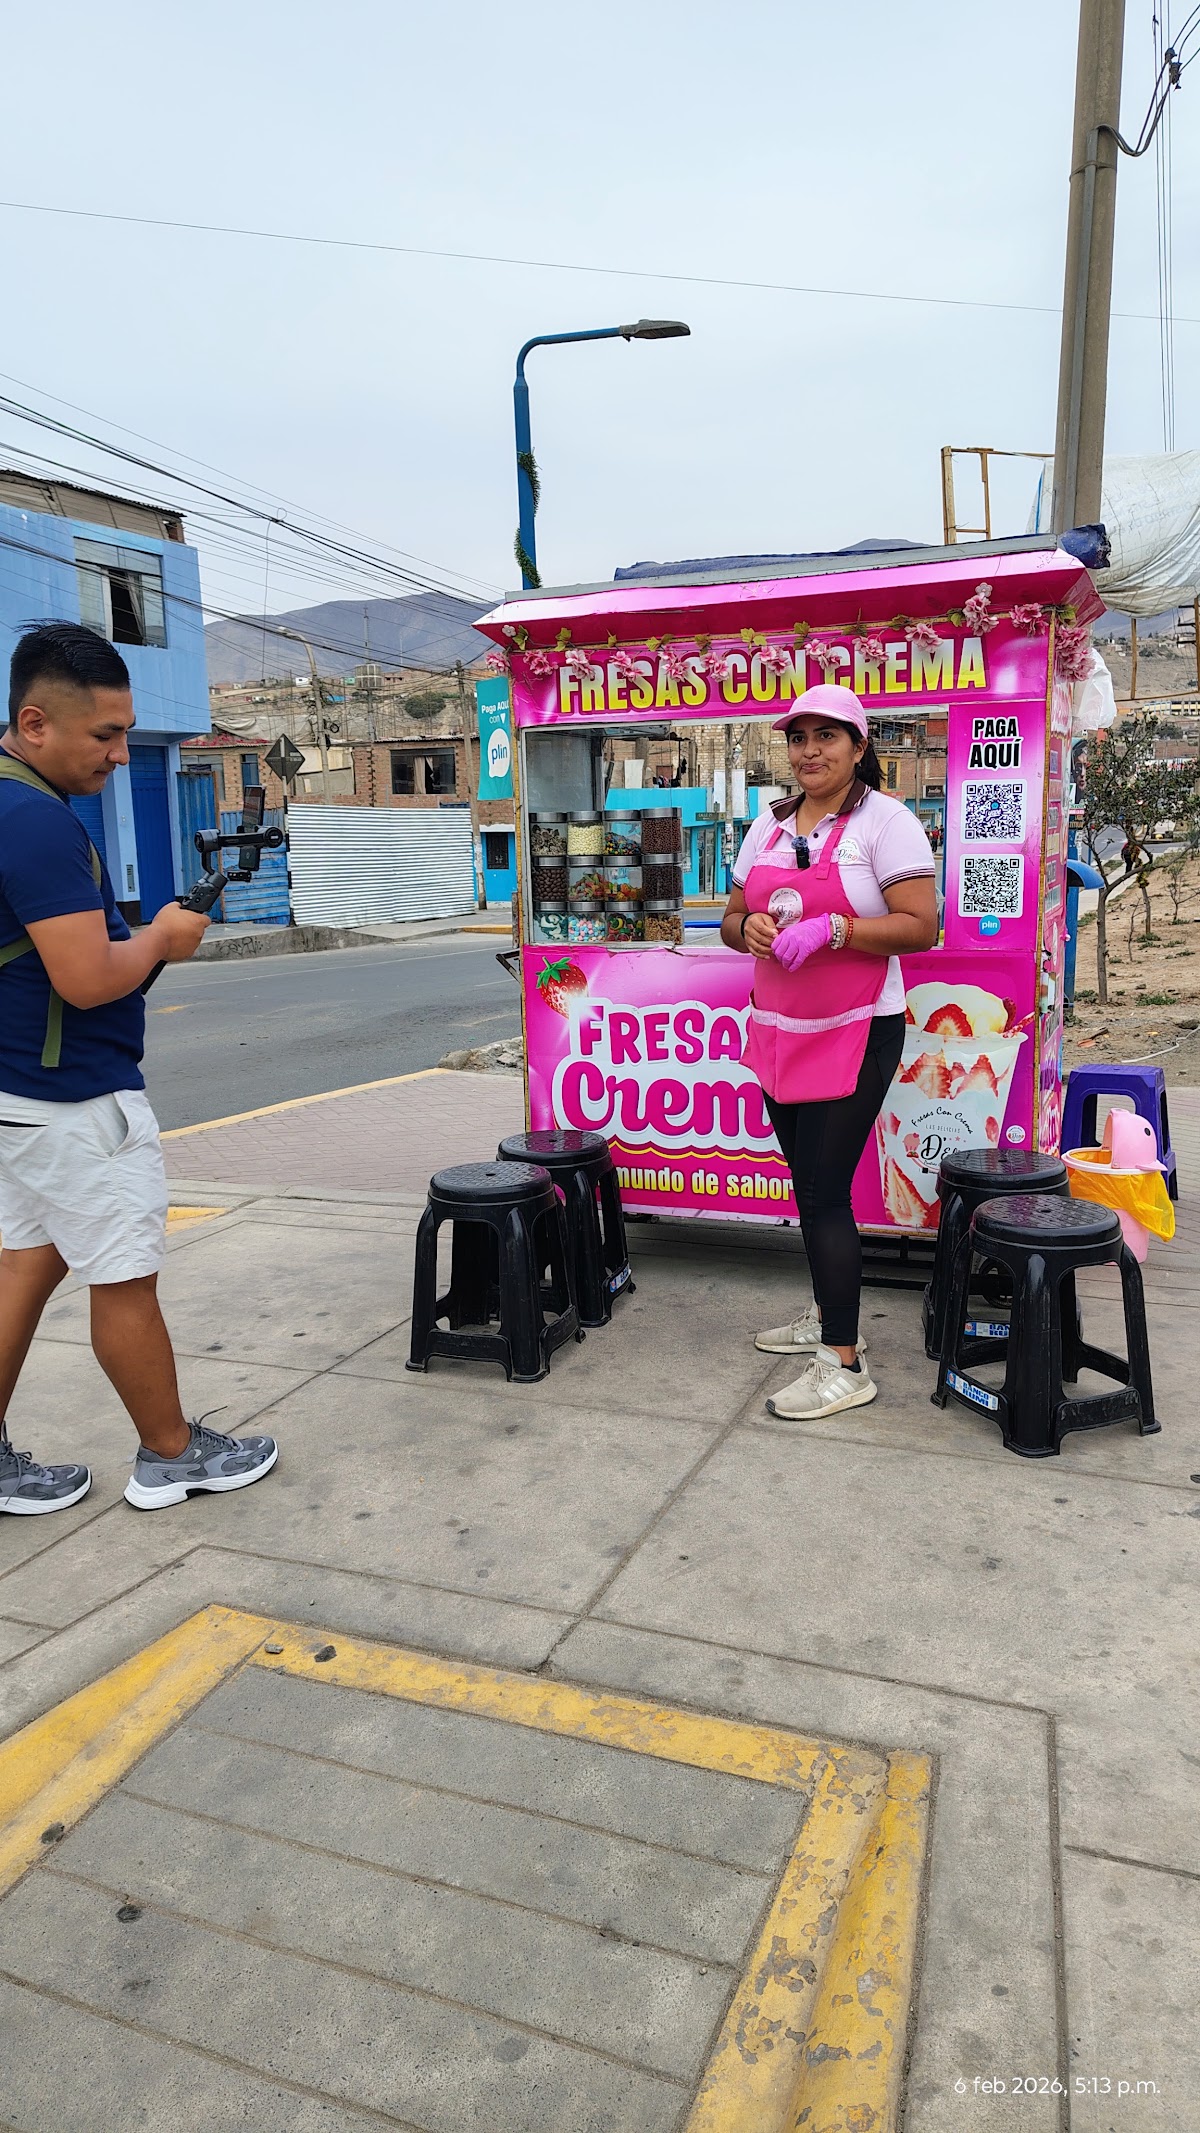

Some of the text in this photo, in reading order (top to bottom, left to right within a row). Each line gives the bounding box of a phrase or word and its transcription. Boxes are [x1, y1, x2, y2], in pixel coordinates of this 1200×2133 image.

[559, 656, 707, 713] FRESAS
[722, 649, 807, 703] CON
[481, 704, 496, 714] Paga
[489, 715, 500, 724] con
[974, 718, 1017, 738] PAGA
[491, 744, 508, 765] plin
[970, 738, 1021, 769] AQUÍ
[981, 920, 998, 930] plin
[579, 1005, 752, 1065] FRESA
[911, 1106, 974, 1135] Fresas Con Crema
[937, 1125, 961, 1134] DELICIAS
[616, 1167, 685, 1193] mundo
[692, 1169, 719, 1195] de
